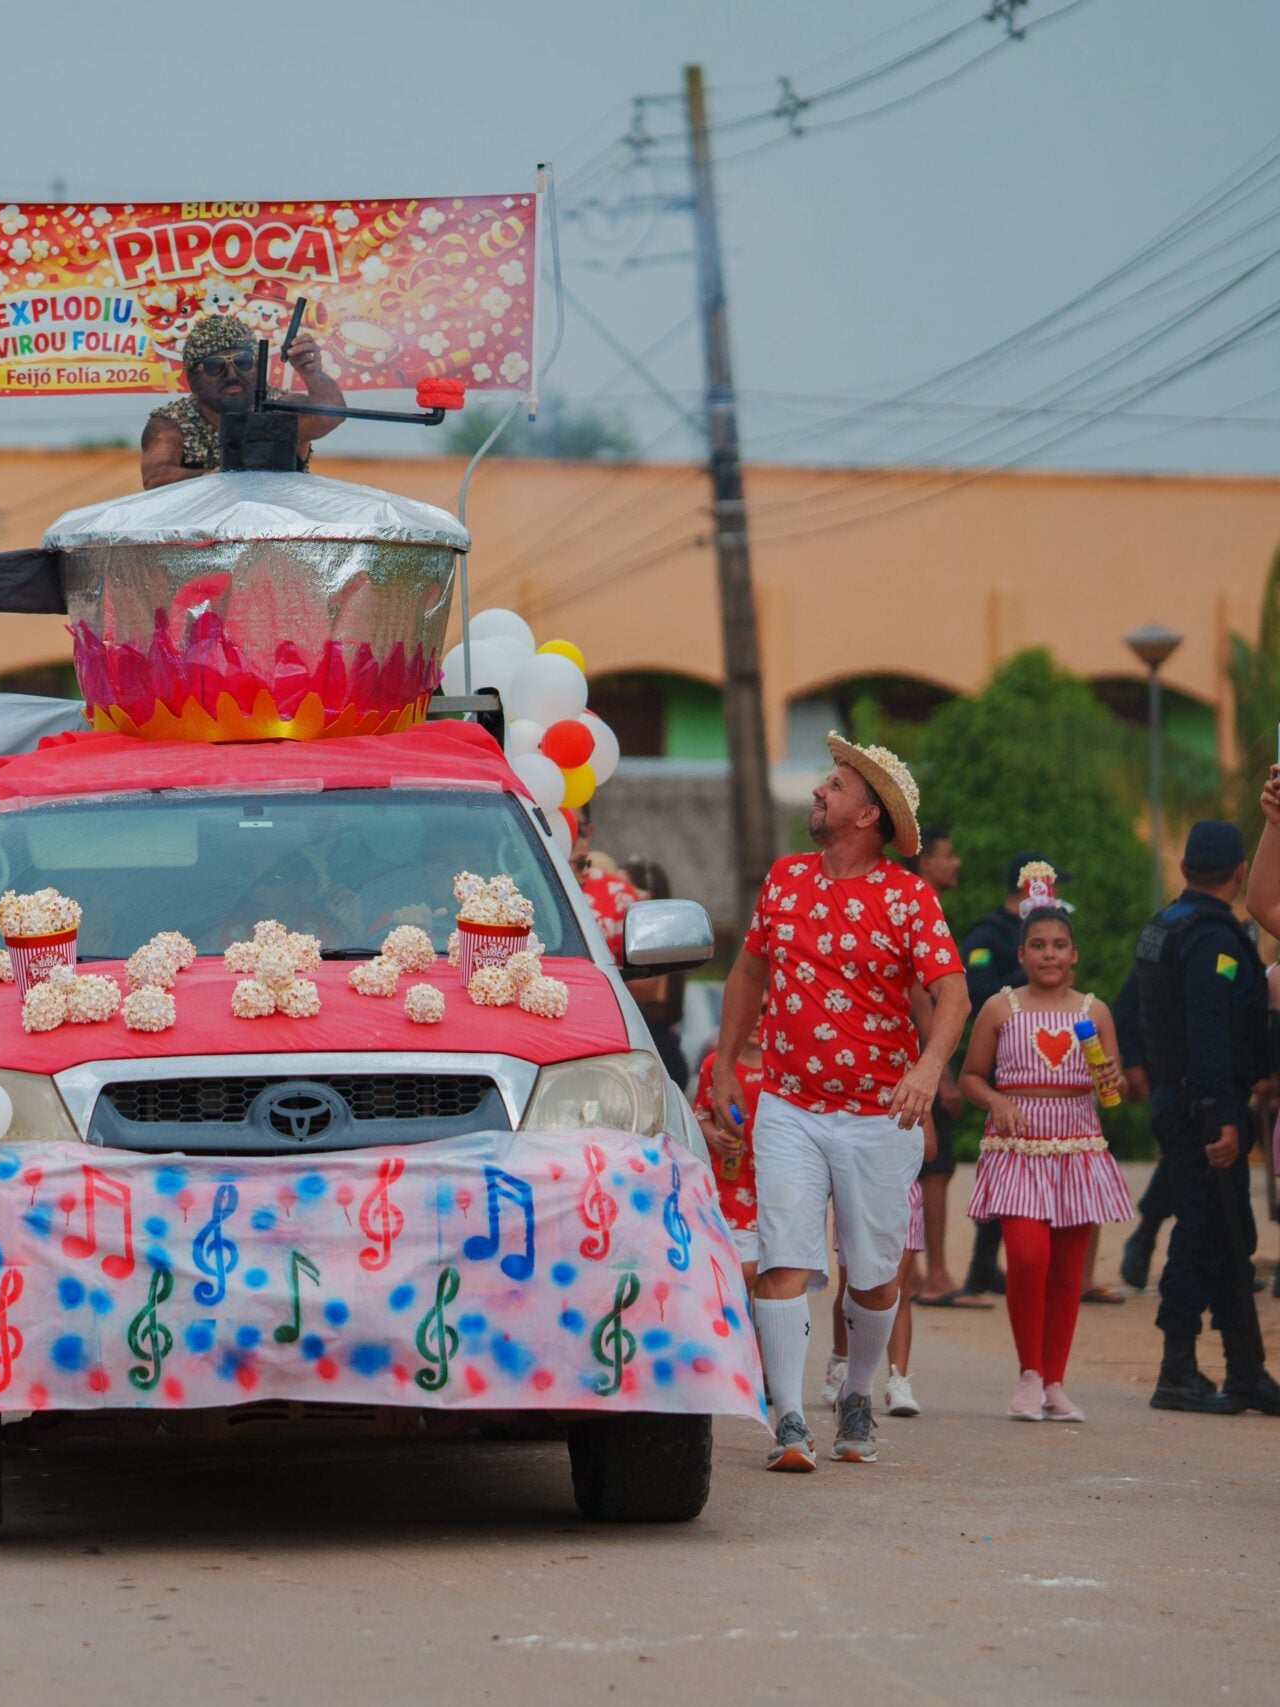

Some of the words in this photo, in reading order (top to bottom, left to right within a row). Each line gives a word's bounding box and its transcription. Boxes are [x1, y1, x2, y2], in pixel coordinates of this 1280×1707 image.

[181, 201, 259, 220] BLOCO
[111, 221, 336, 285] PIPOCA
[72, 330, 148, 358] FOLIA!
[6, 367, 51, 388] Feijó
[104, 367, 151, 384] 2026
